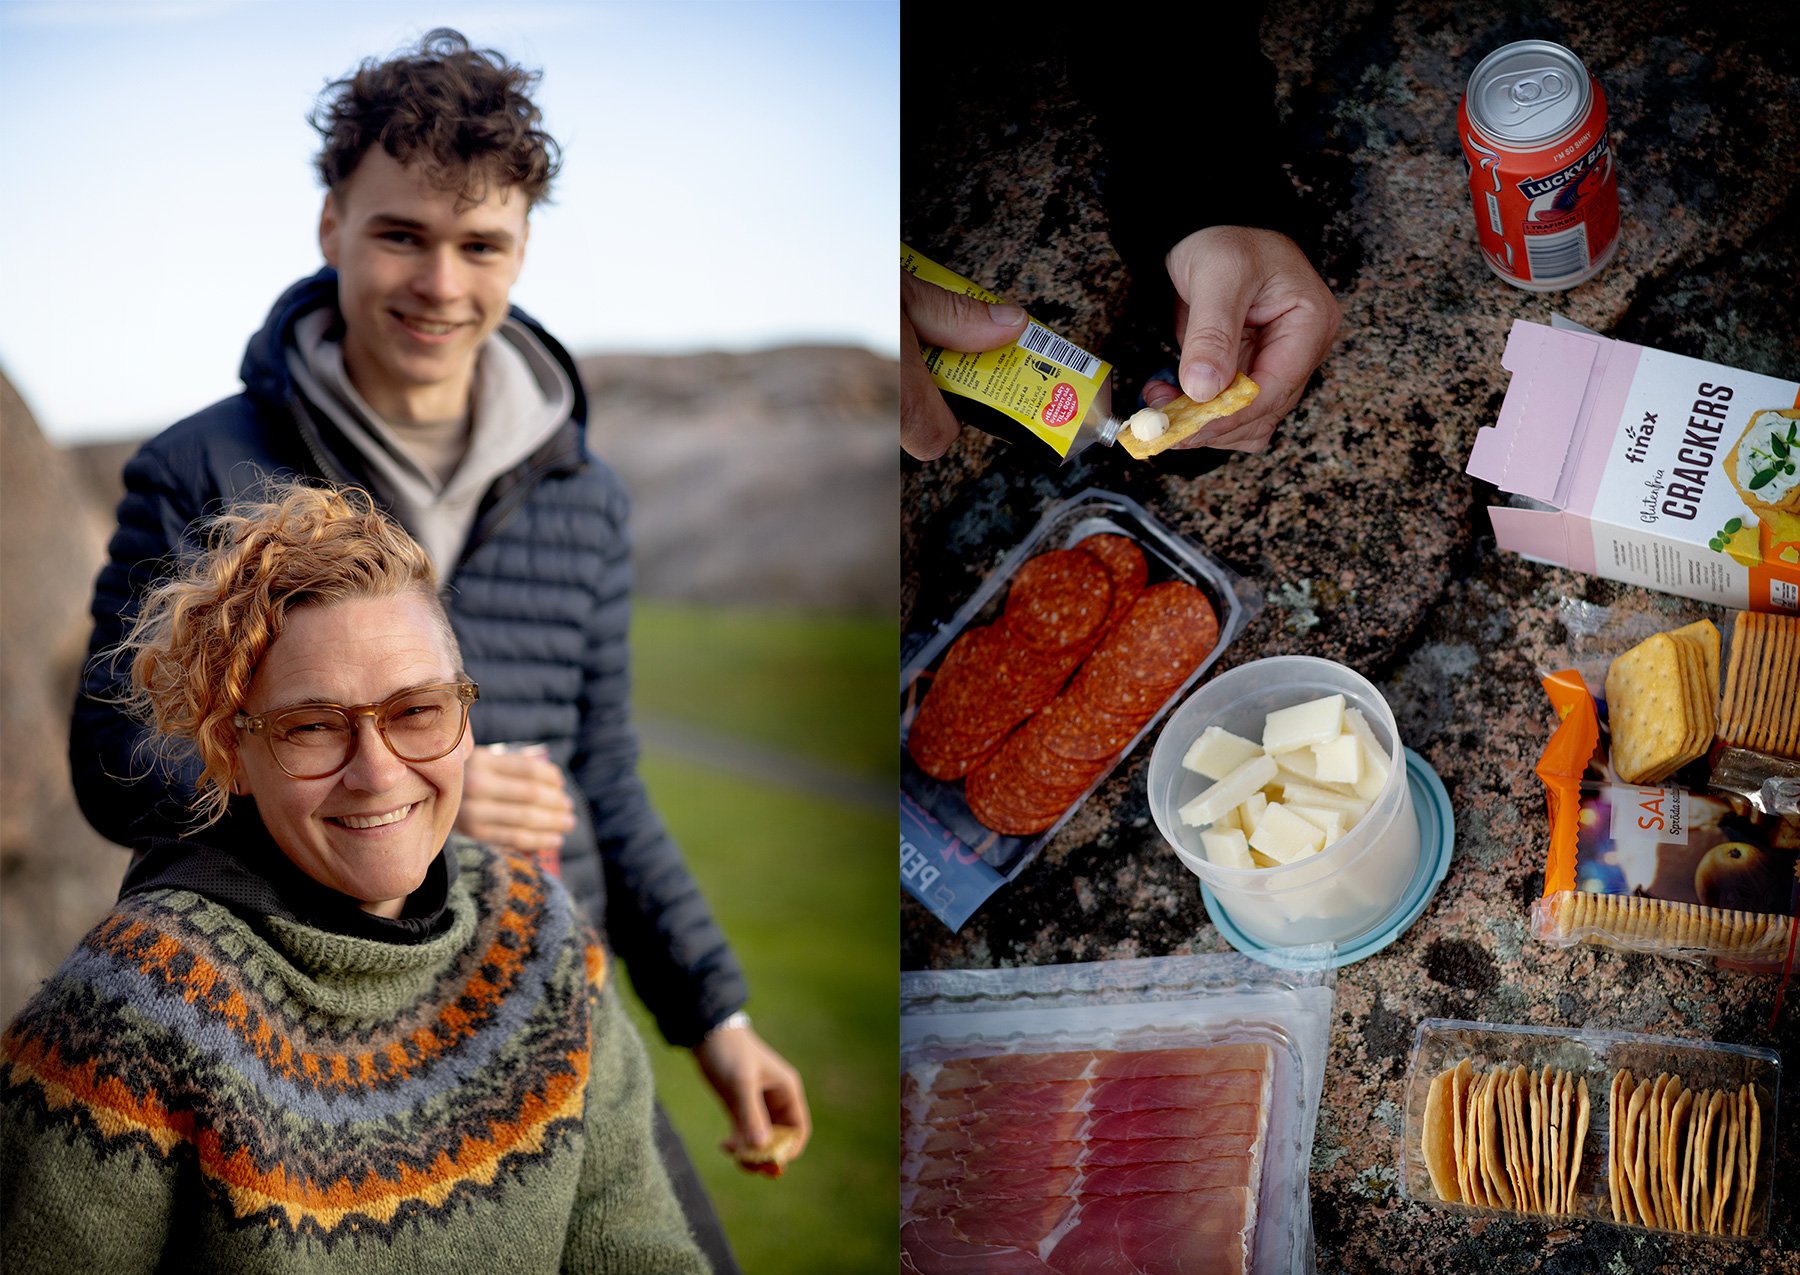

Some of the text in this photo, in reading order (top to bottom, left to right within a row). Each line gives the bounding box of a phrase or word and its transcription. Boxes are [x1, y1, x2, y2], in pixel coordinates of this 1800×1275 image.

[1565, 146, 1575, 156] SO
[1574, 131, 1591, 149] SHINY
[1528, 160, 1584, 196] LUCKY
[1044, 403, 1055, 420] HELA
[1053, 385, 1064, 402] VÅRT
[1056, 393, 1073, 422] TILL GODA
[1625, 411, 1659, 463] finax
[1661, 382, 1734, 520] CRACKERS
[1640, 469, 1665, 523] Glutenfria
[1669, 803, 1682, 835] Spröda
